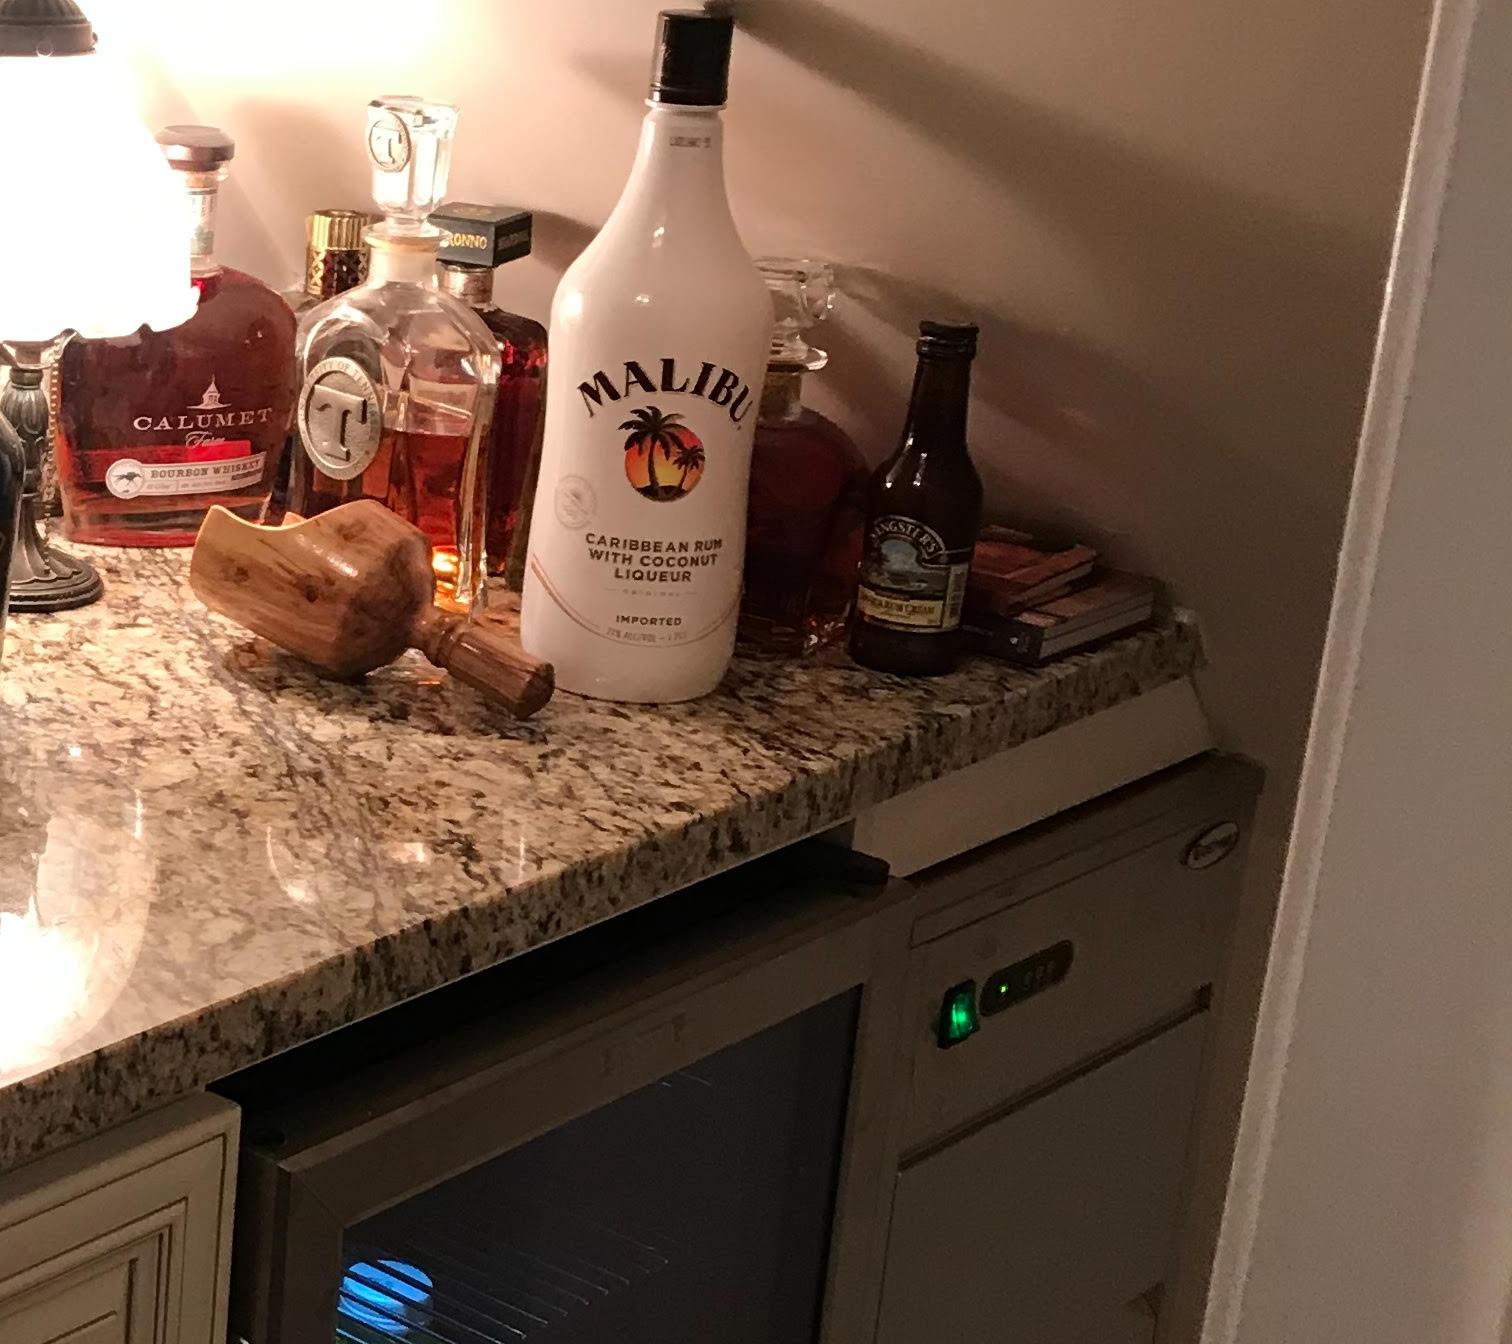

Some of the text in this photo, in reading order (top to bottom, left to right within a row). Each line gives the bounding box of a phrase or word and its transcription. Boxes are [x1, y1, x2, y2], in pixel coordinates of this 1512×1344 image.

[577, 358, 753, 422] MALIBU
[133, 408, 273, 431] CALUMET
[150, 459, 260, 479] BOURBON WHISKEY
[585, 532, 723, 553] CARIBBEAN RUM
[589, 548, 718, 568] WITH COCONUT
[614, 568, 692, 582] LIQUEUR
[616, 615, 682, 626] IMPORTED
